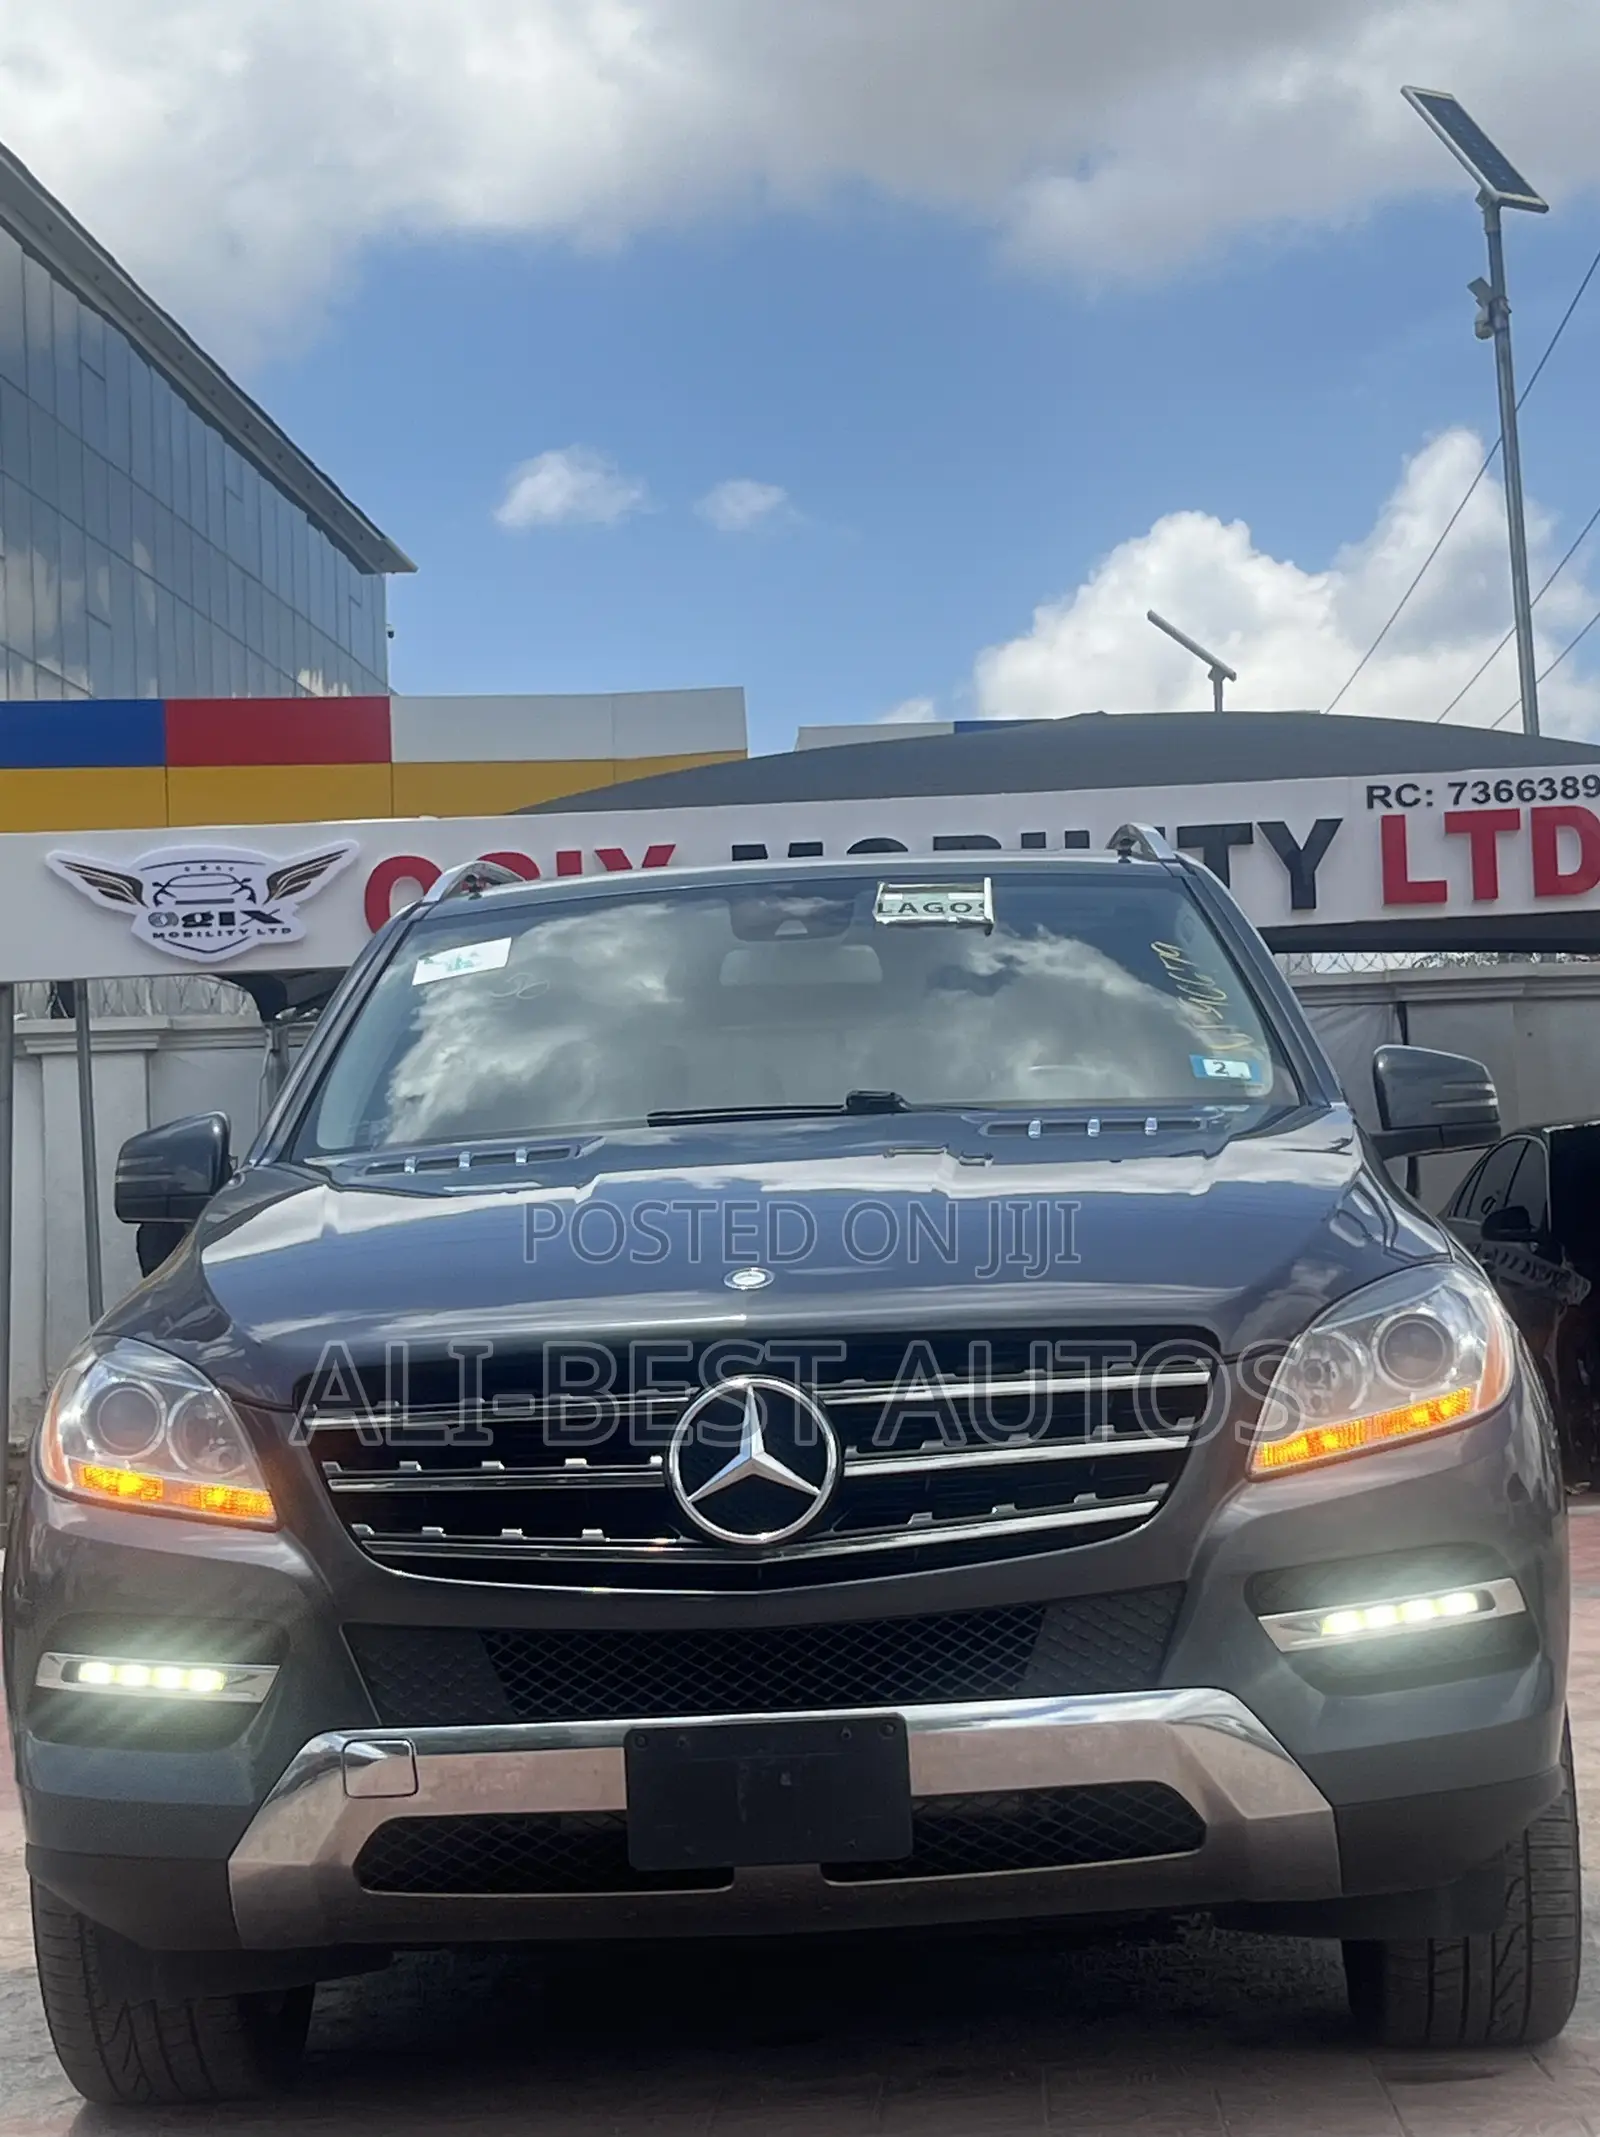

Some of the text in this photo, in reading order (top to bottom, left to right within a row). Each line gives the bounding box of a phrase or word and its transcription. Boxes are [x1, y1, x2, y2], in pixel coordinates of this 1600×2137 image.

[1366, 774, 1600, 810] RC: 7366389
[1380, 804, 1600, 905] LTD
[152, 927, 292, 939] MOBILITY LTD
